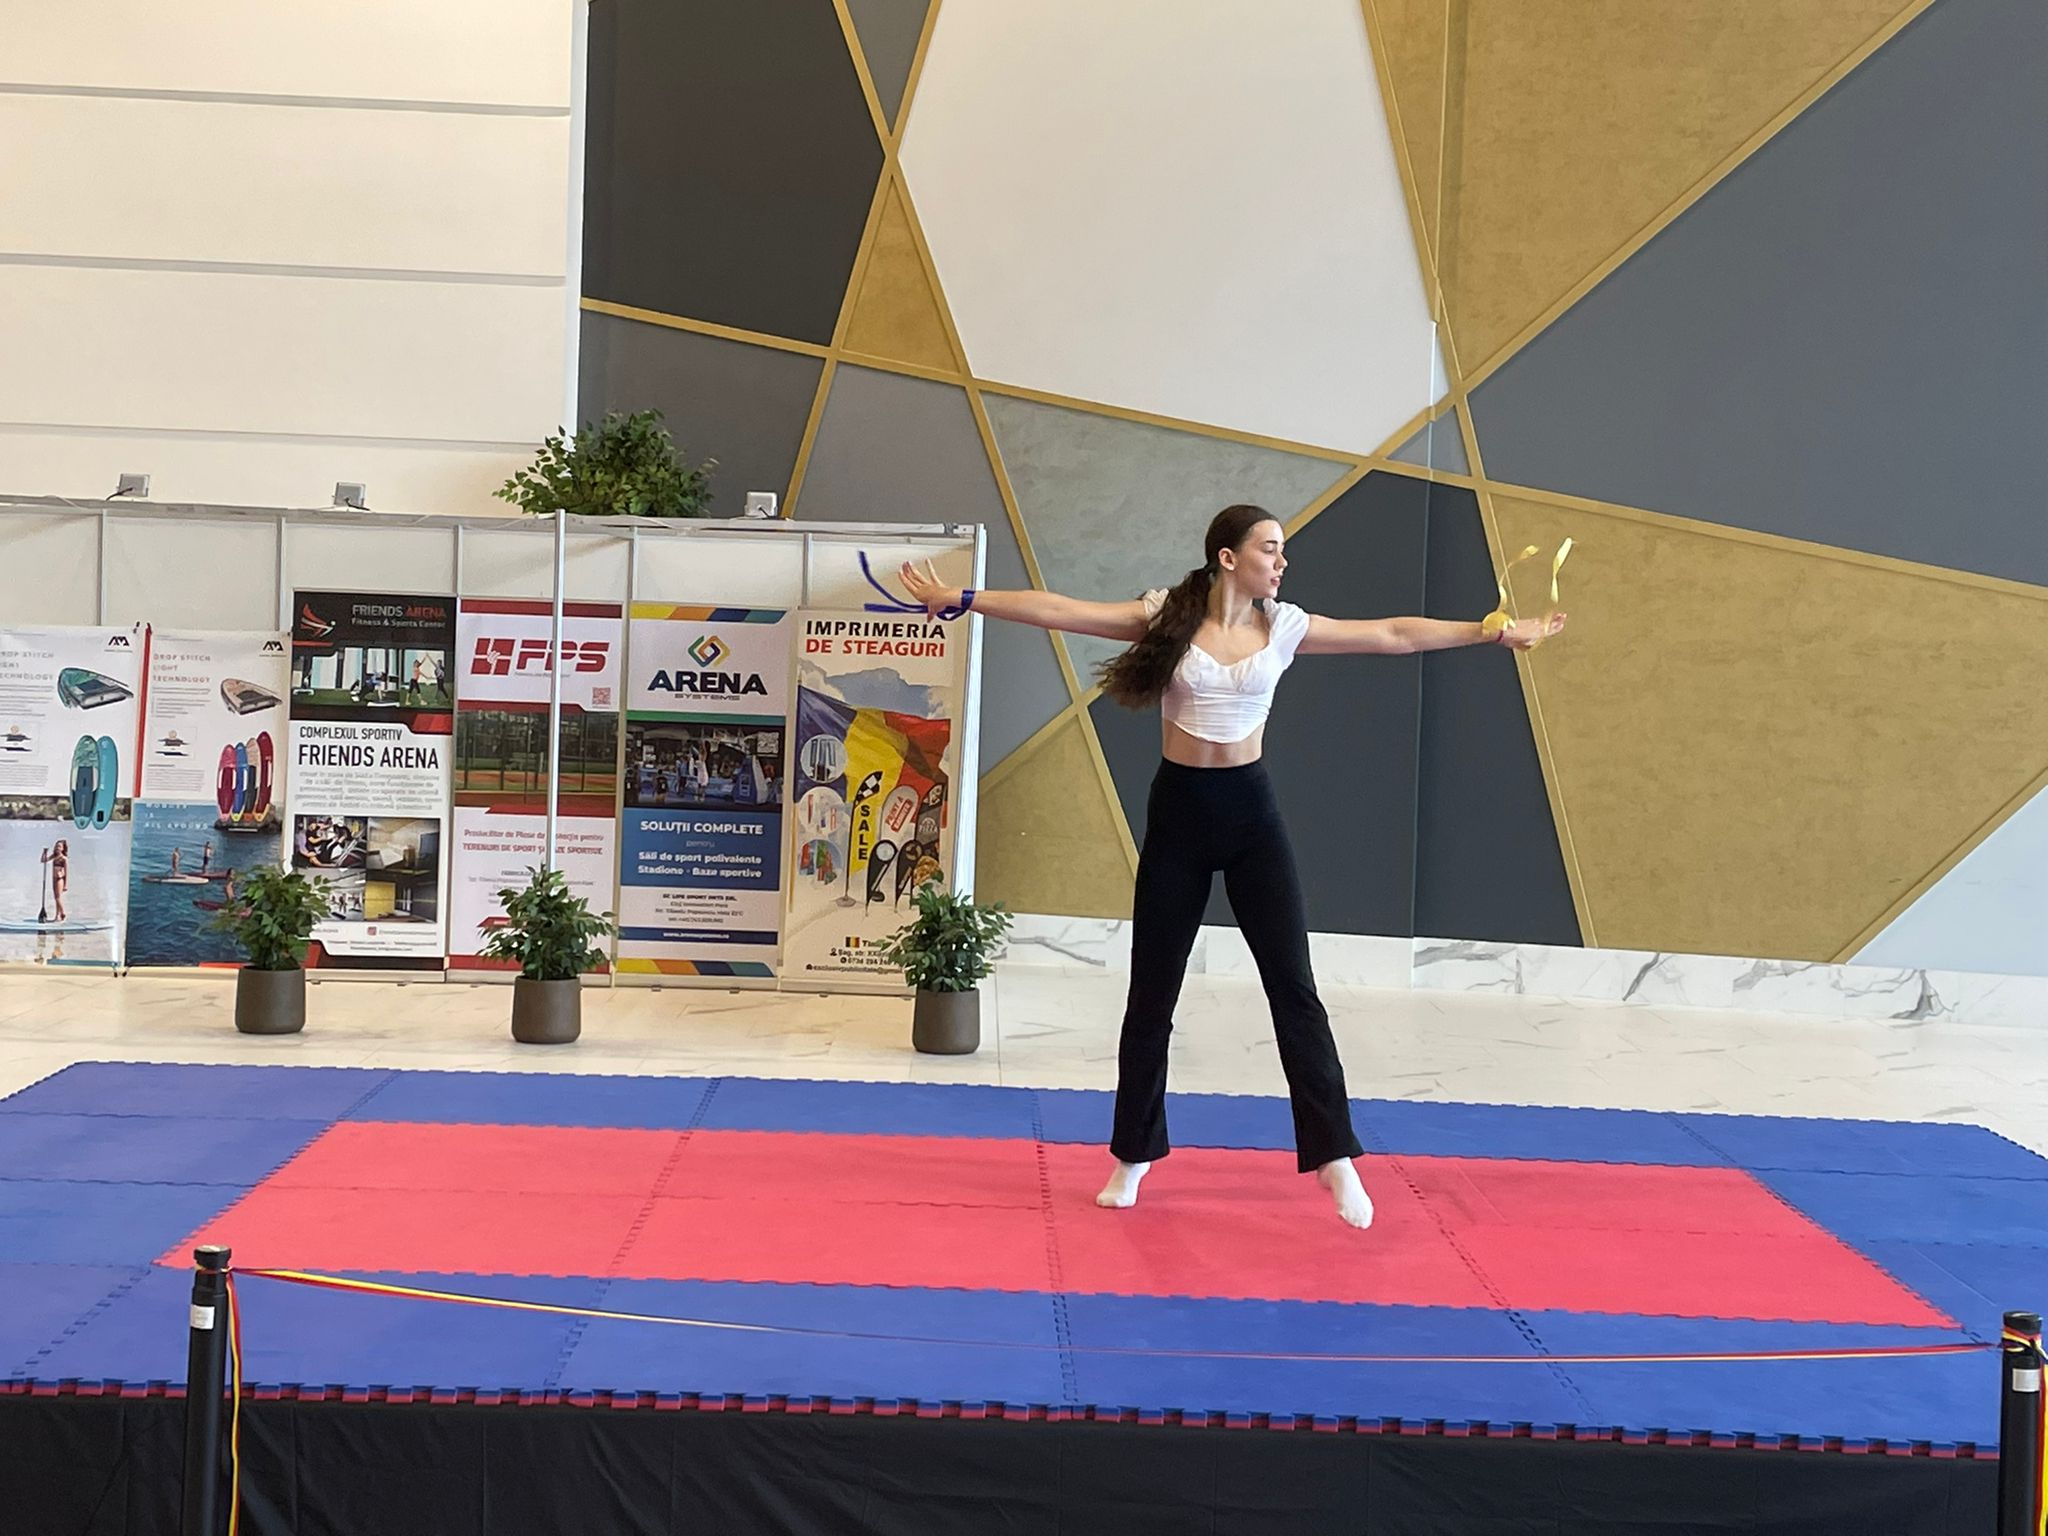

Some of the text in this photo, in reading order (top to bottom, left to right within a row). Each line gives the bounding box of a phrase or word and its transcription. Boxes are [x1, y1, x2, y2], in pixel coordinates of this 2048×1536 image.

[352, 605, 447, 619] FRIENDS ARENA
[352, 617, 381, 626] Fitness
[391, 618, 417, 628] Sports
[806, 620, 946, 640] IMPRIMERIA
[806, 639, 945, 657] DE STEAGURI
[153, 653, 177, 661] DROP
[515, 639, 610, 673] FPS
[647, 669, 768, 695] ARENA
[674, 693, 741, 701] SYSTEMS
[300, 726, 403, 741] COMPLEXUL SPORTIV
[298, 743, 439, 769] FRIENDS ARENA
[640, 820, 763, 835] SOLUȚII COMPLETE
[858, 805, 870, 860] SALE
[659, 852, 673, 862] de
[674, 853, 702, 864] sport
[704, 854, 762, 865] polivalente
[719, 868, 762, 878] sportive
